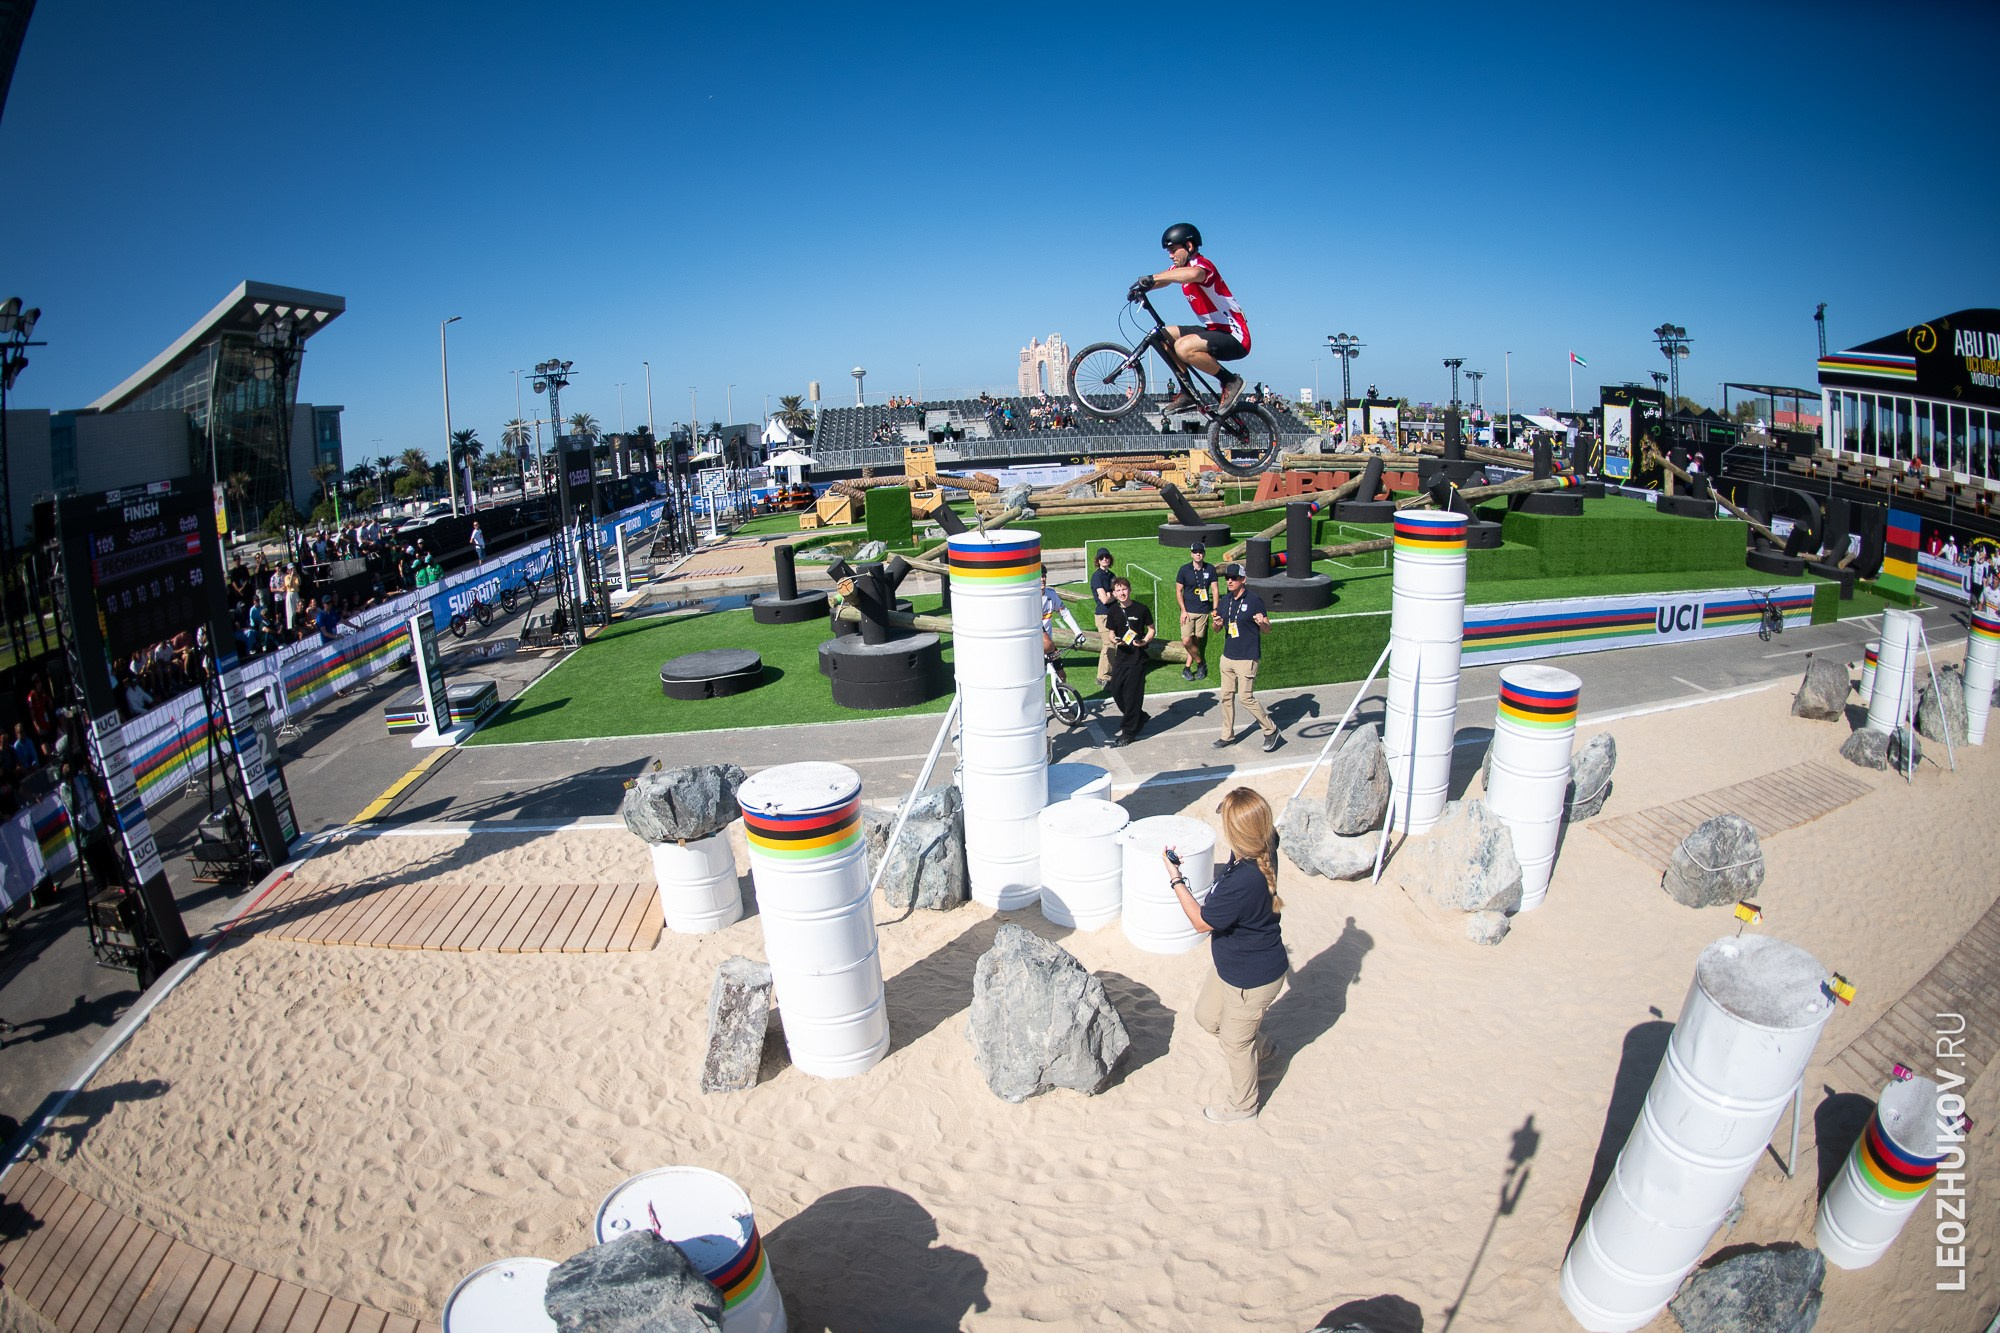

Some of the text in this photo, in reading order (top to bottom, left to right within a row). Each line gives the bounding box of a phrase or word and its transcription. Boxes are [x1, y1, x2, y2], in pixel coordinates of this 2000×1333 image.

[1954, 329, 1984, 358] ABU
[1970, 372, 1995, 388] WORLD
[123, 501, 160, 523] FINISH
[96, 534, 115, 555] 105
[179, 514, 198, 532] 0:00
[106, 594, 118, 614] 10
[121, 590, 133, 608] 10
[136, 584, 147, 603] 10
[150, 579, 161, 599] 10
[164, 575, 175, 593] 10
[189, 567, 203, 587] 50
[1658, 604, 1699, 633] UCI
[422, 630, 436, 643] START
[427, 642, 436, 665] 3
[100, 714, 118, 732] UCI
[256, 732, 272, 764] 2
[110, 758, 127, 771] TISSOT
[251, 763, 263, 779] UCI
[137, 840, 155, 859] UCI
